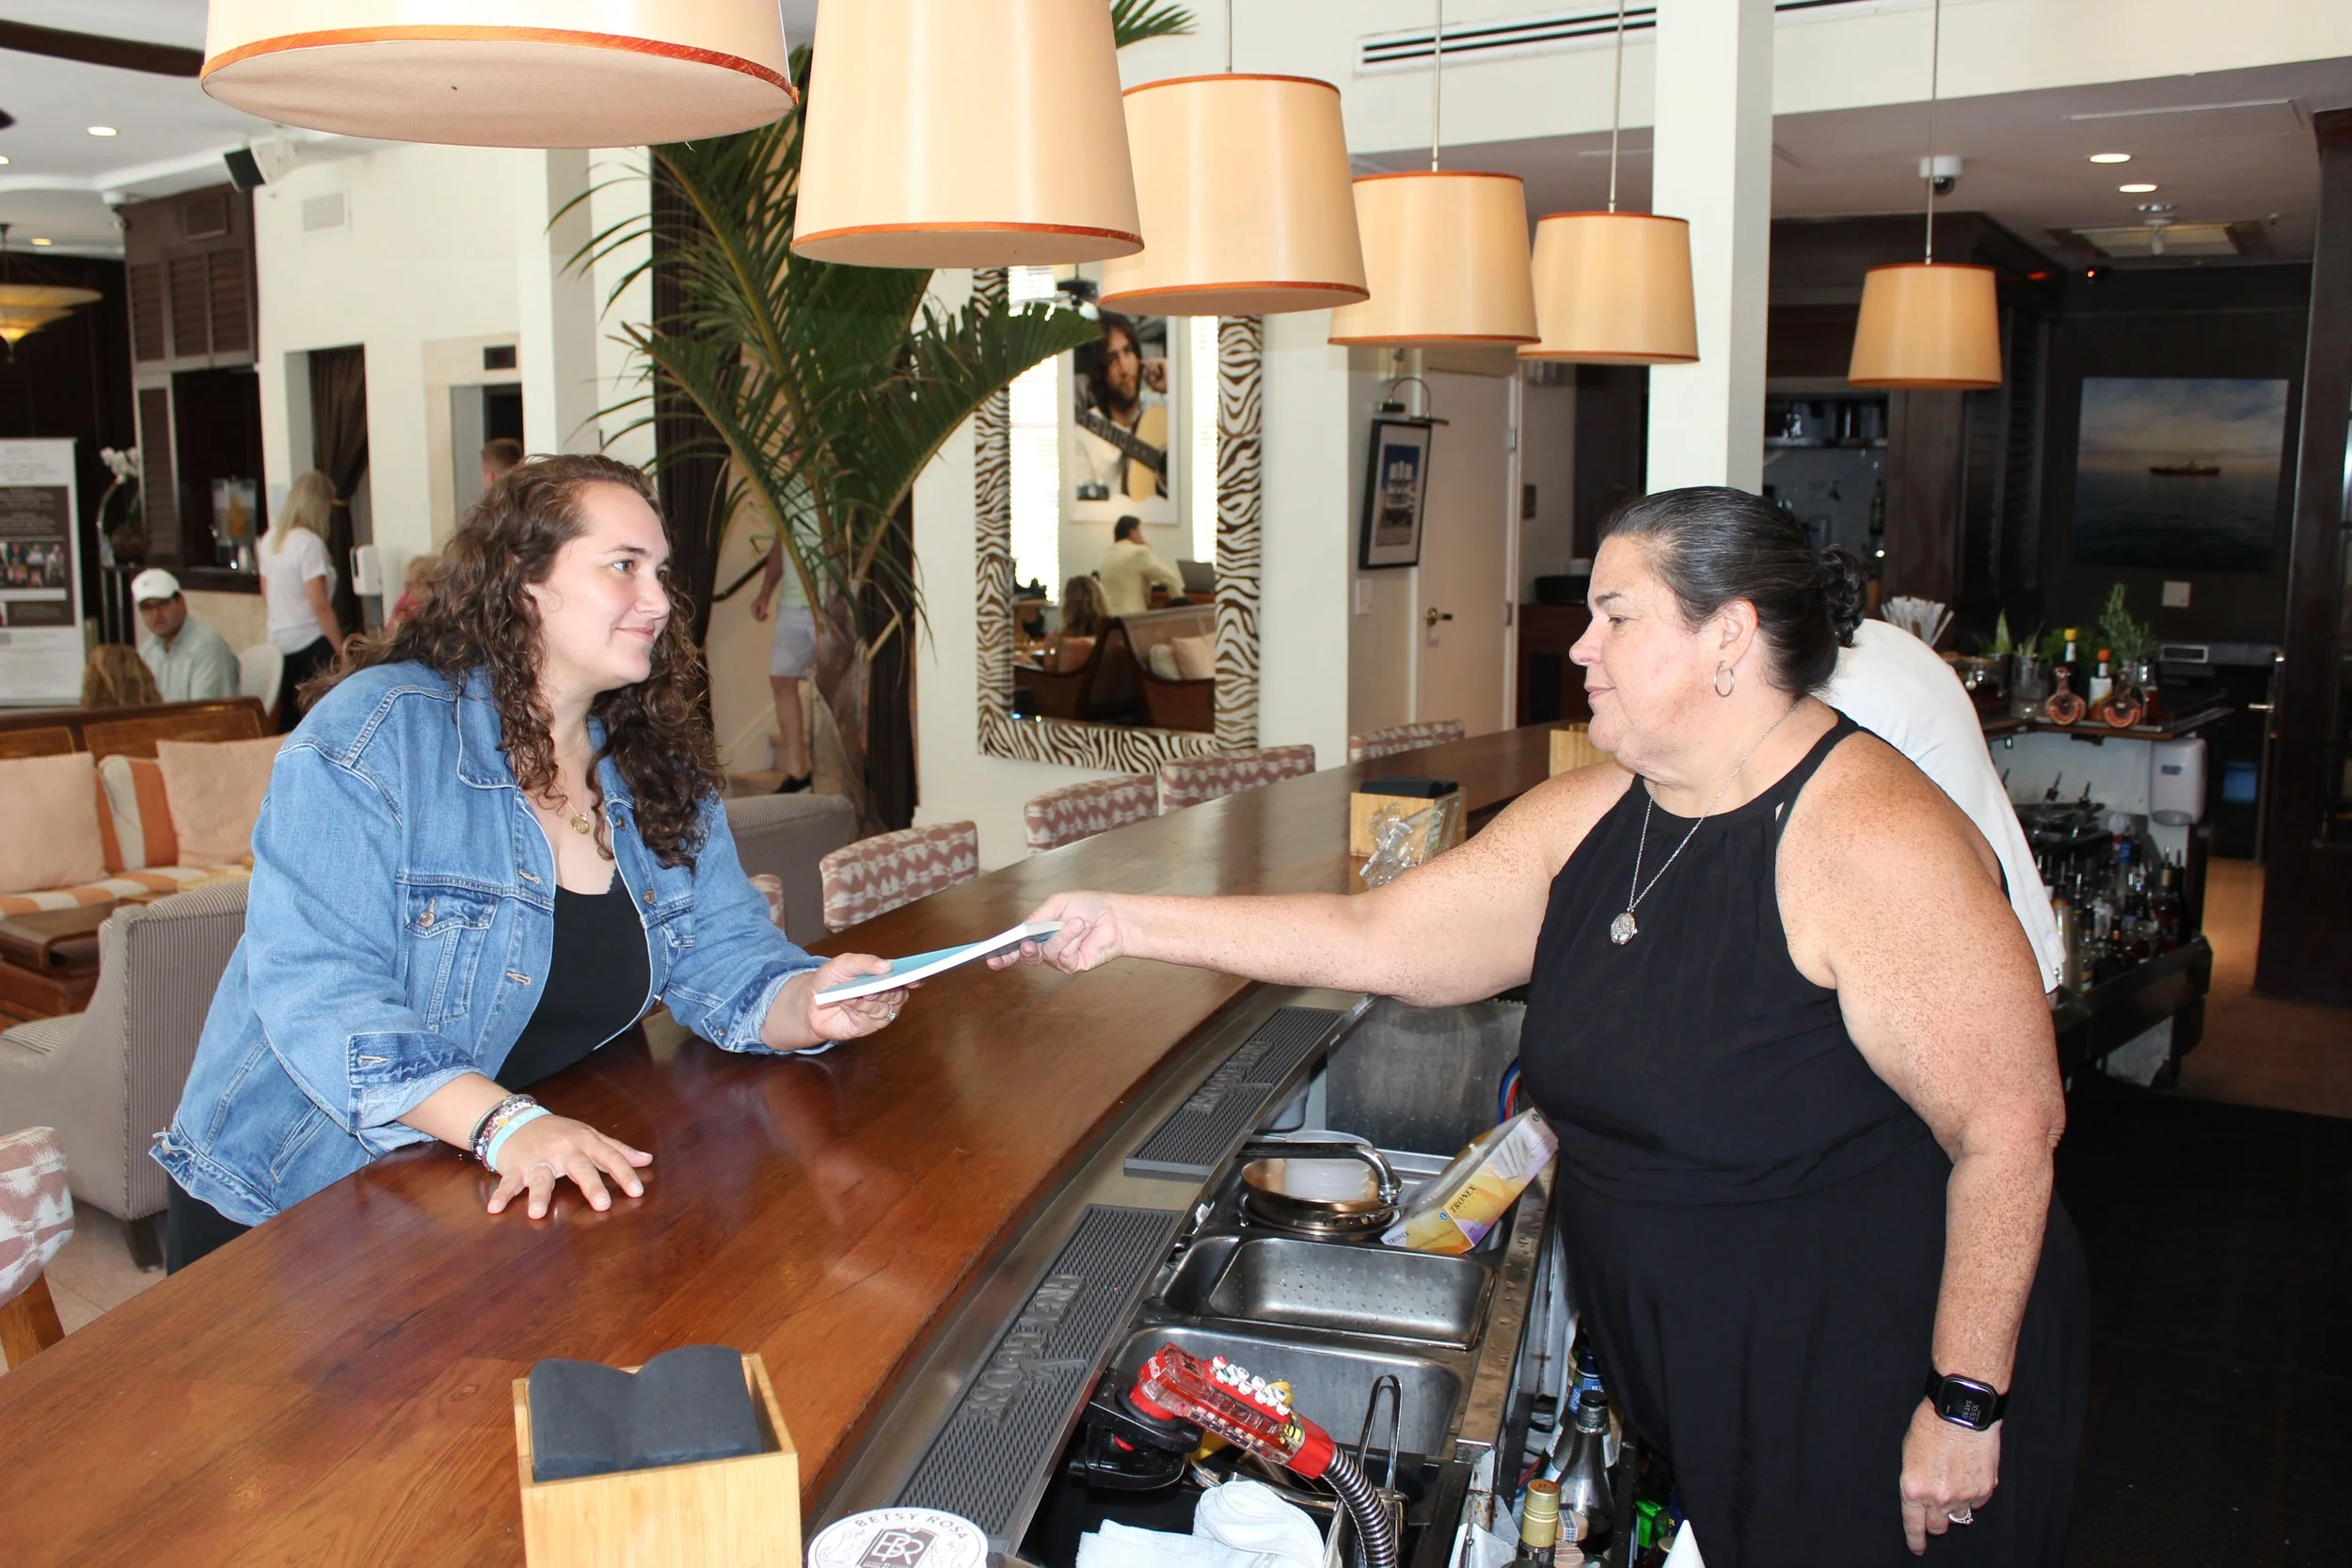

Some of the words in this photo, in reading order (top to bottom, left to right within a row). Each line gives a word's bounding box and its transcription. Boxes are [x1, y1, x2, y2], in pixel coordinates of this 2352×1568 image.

[1449, 1183, 1477, 1214] TRONEX
[1386, 1229, 1411, 1245] TRONEX
[854, 1513, 919, 1527] BETSY
